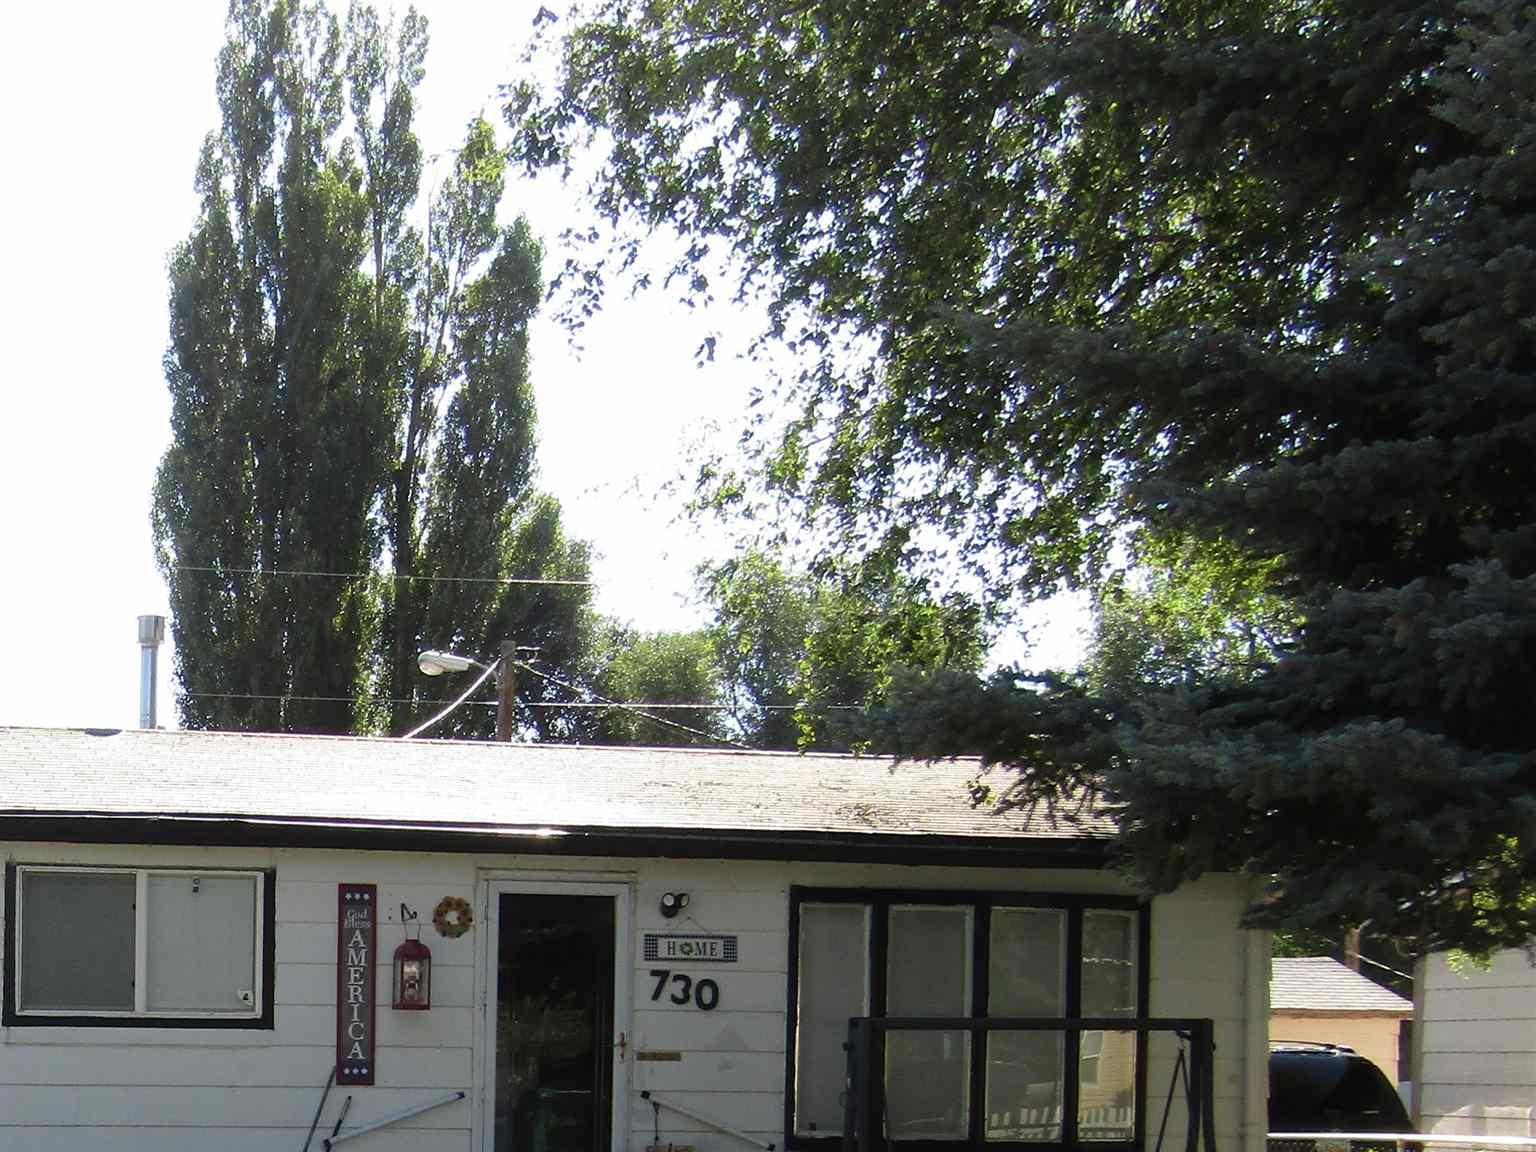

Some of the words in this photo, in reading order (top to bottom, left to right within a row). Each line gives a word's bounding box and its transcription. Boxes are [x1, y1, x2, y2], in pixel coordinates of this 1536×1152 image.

[667, 941, 718, 957] HOME
[347, 930, 368, 1059] AMERICA
[650, 969, 719, 1011] 730
